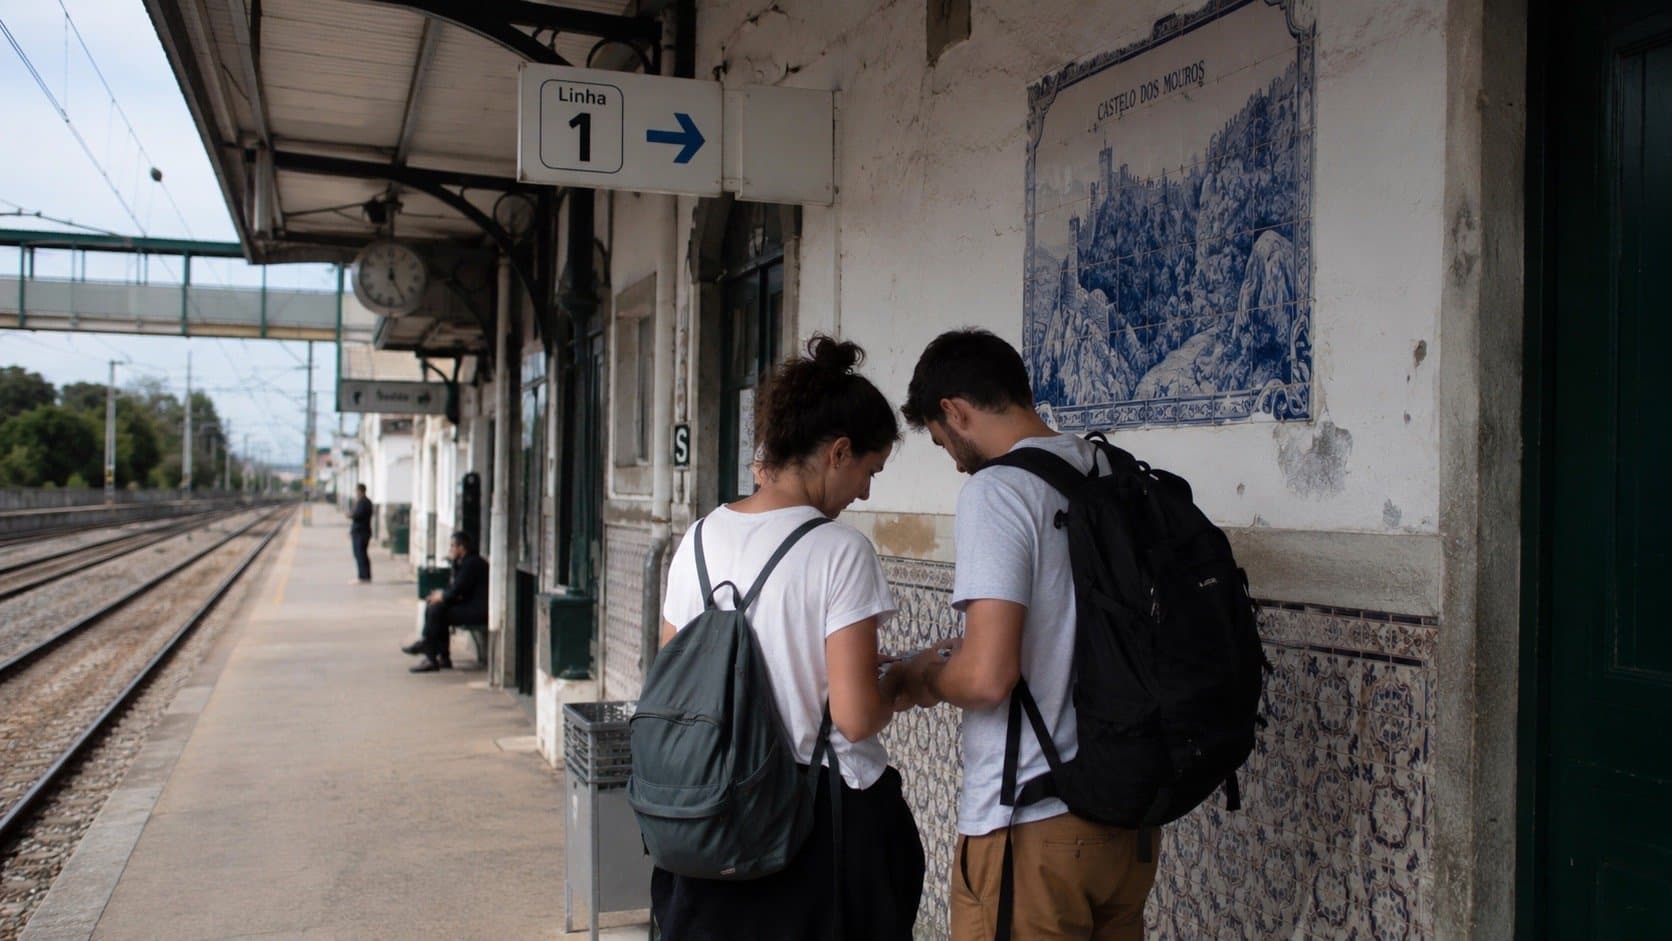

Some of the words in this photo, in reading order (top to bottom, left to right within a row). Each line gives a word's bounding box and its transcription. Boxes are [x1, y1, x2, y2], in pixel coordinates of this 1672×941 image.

[559, 87, 606, 105] Linha
[1098, 89, 1136, 121] CASTELO
[1141, 80, 1159, 104] DOS
[1164, 60, 1205, 93] MOUROS
[569, 112, 591, 162] 1
[676, 428, 687, 463] S
